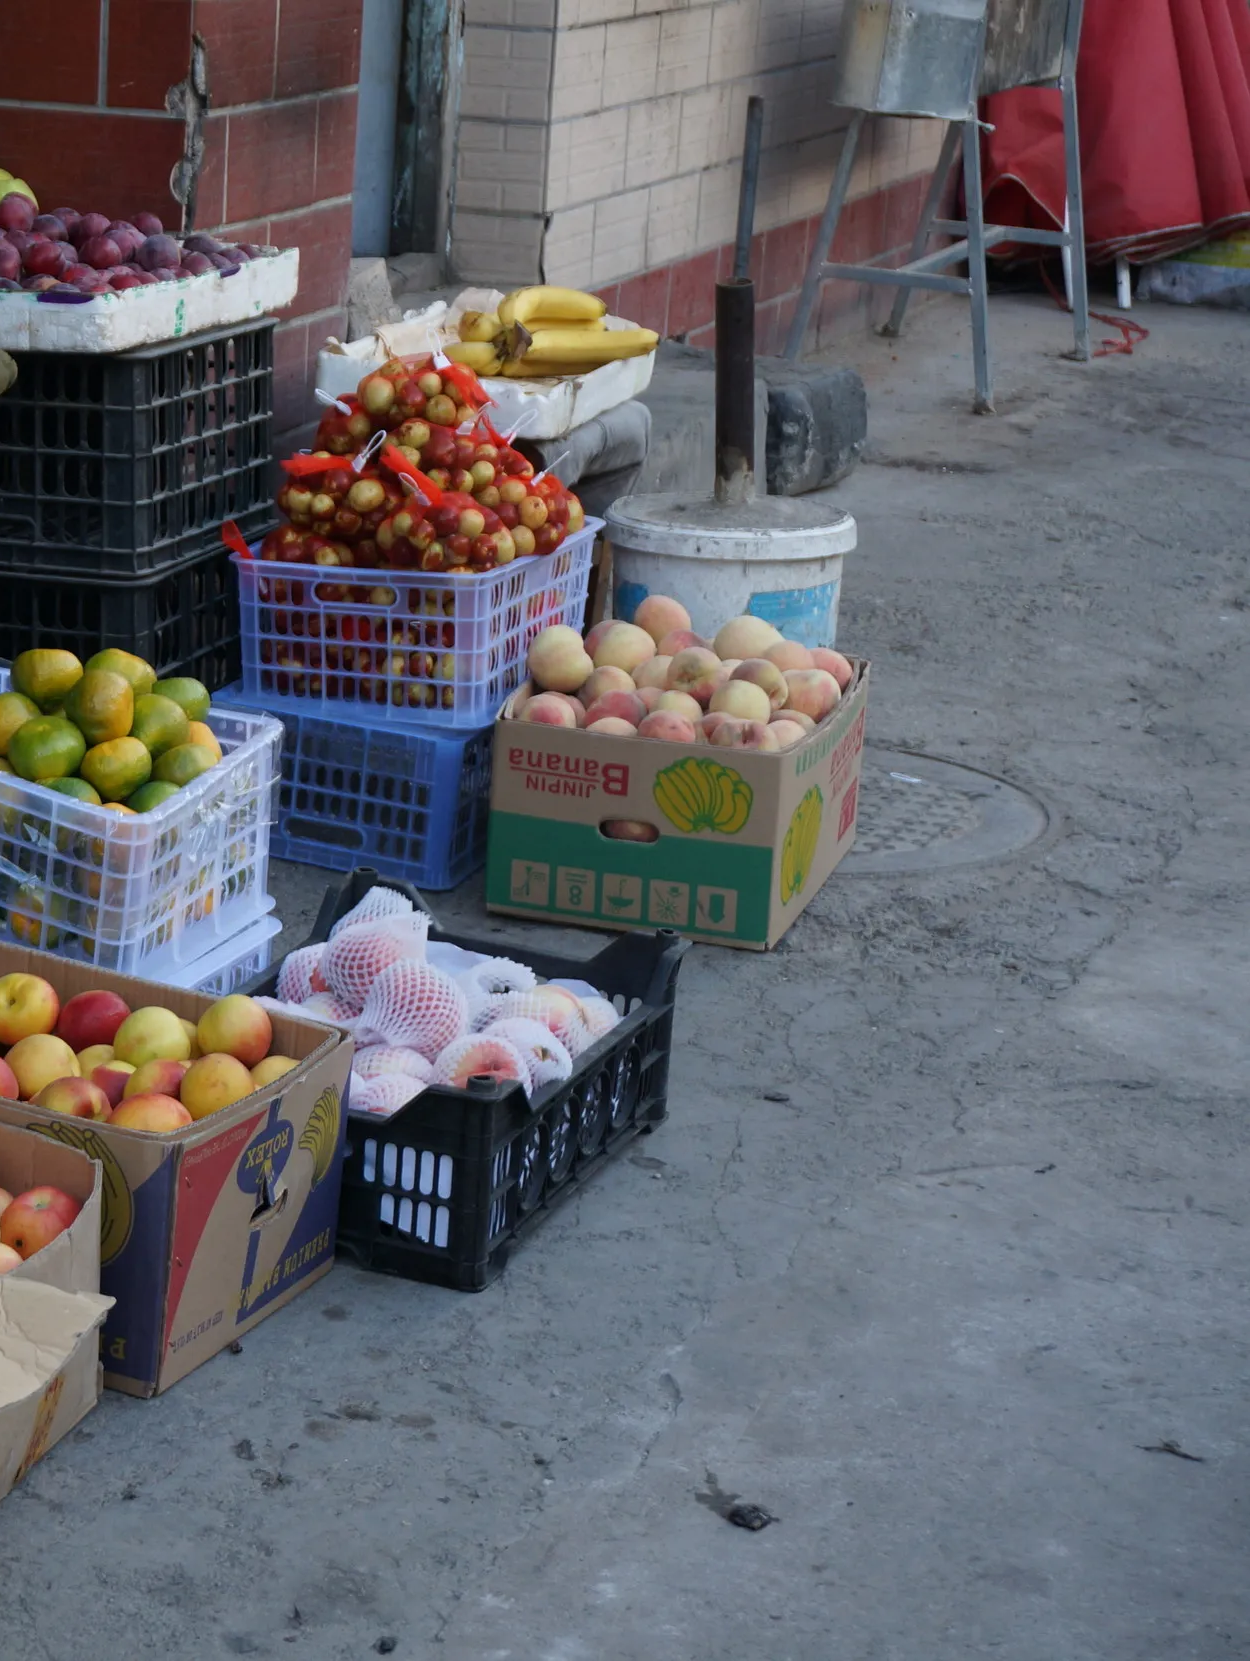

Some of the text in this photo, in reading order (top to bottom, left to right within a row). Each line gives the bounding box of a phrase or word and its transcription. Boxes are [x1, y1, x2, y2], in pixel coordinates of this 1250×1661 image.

[508, 747, 630, 798] Banana
[526, 774, 597, 799] JINPIN
[244, 1127, 290, 1169] ROLEX
[283, 1226, 330, 1279] PREMIUM
